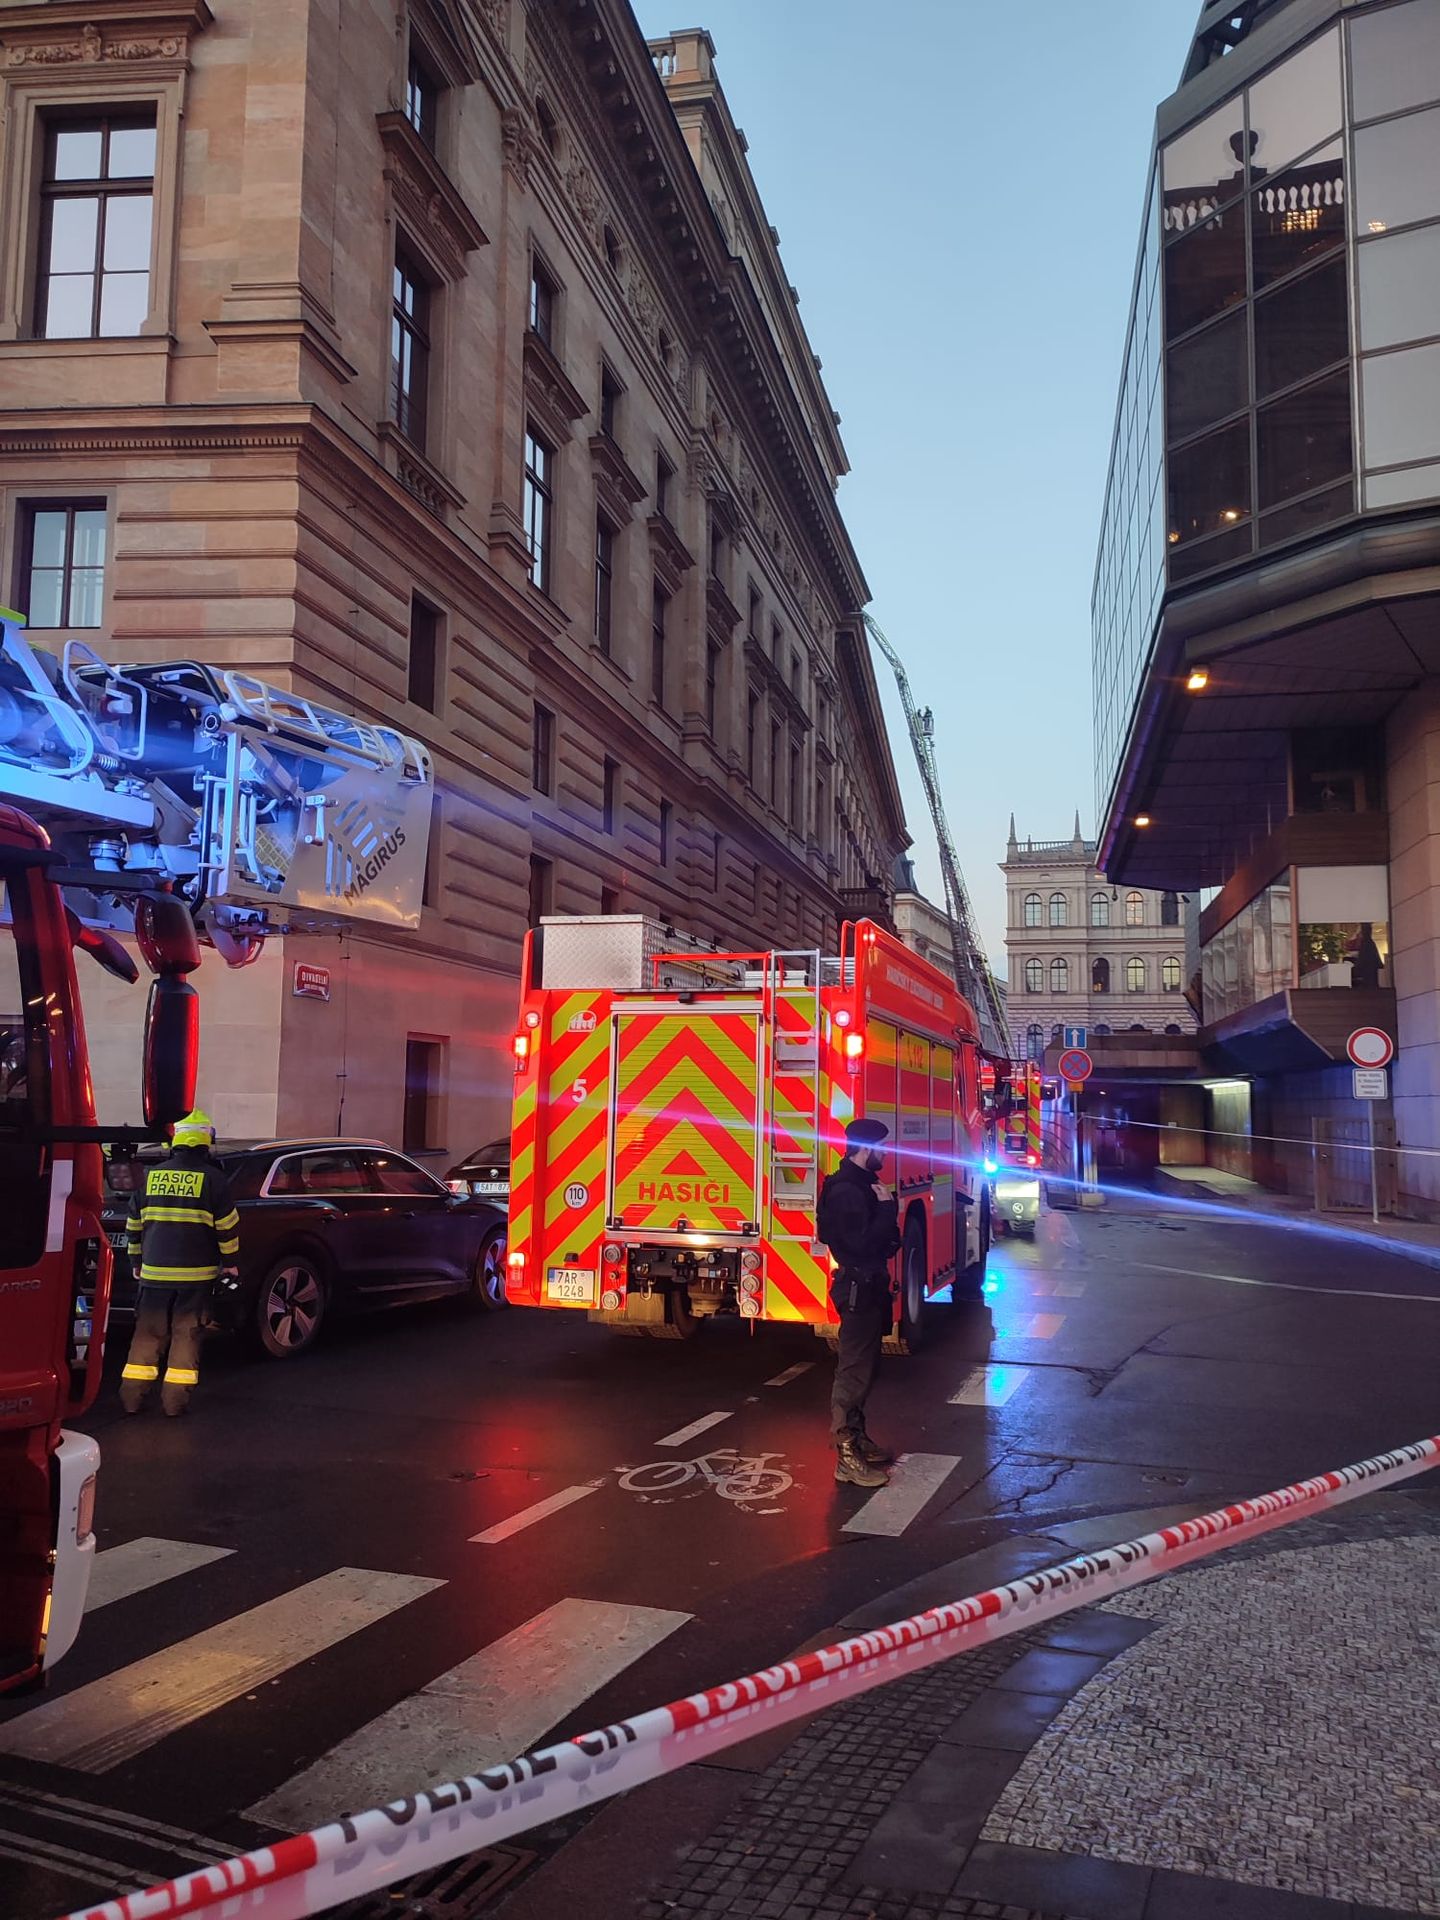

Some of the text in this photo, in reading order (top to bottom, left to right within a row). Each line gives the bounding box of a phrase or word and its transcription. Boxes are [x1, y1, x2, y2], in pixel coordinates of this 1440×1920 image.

[344, 827, 406, 906] MAGIRUS
[571, 1078, 587, 1103] 5
[150, 1184, 195, 1196] PRAHA
[569, 1187, 584, 1200] 110
[638, 1179, 730, 1204] HASIČI
[558, 1272, 577, 1284] 7AR
[559, 1285, 584, 1298] 1248
